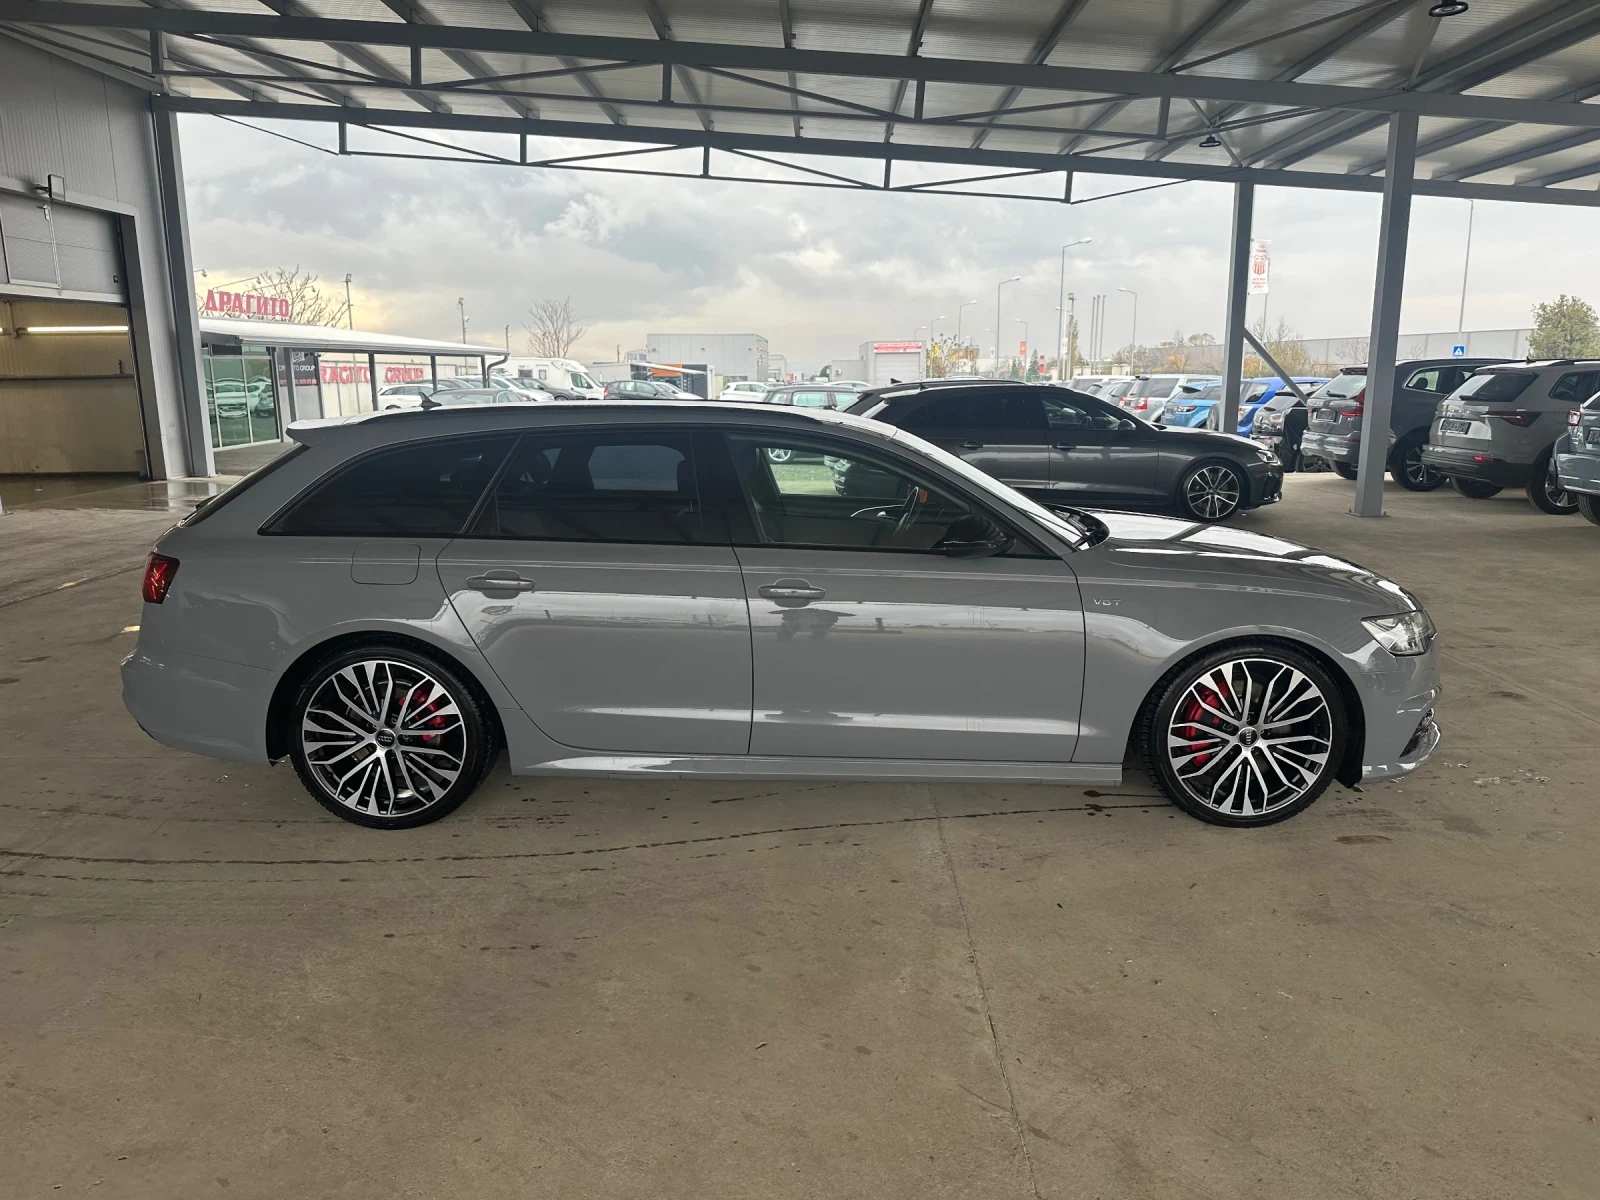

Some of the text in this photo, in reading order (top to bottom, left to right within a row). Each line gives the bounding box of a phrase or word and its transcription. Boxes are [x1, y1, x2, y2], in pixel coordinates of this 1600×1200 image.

[205, 289, 289, 317] ДРАГИТО
[320, 365, 423, 384] RAGITO GROUP
